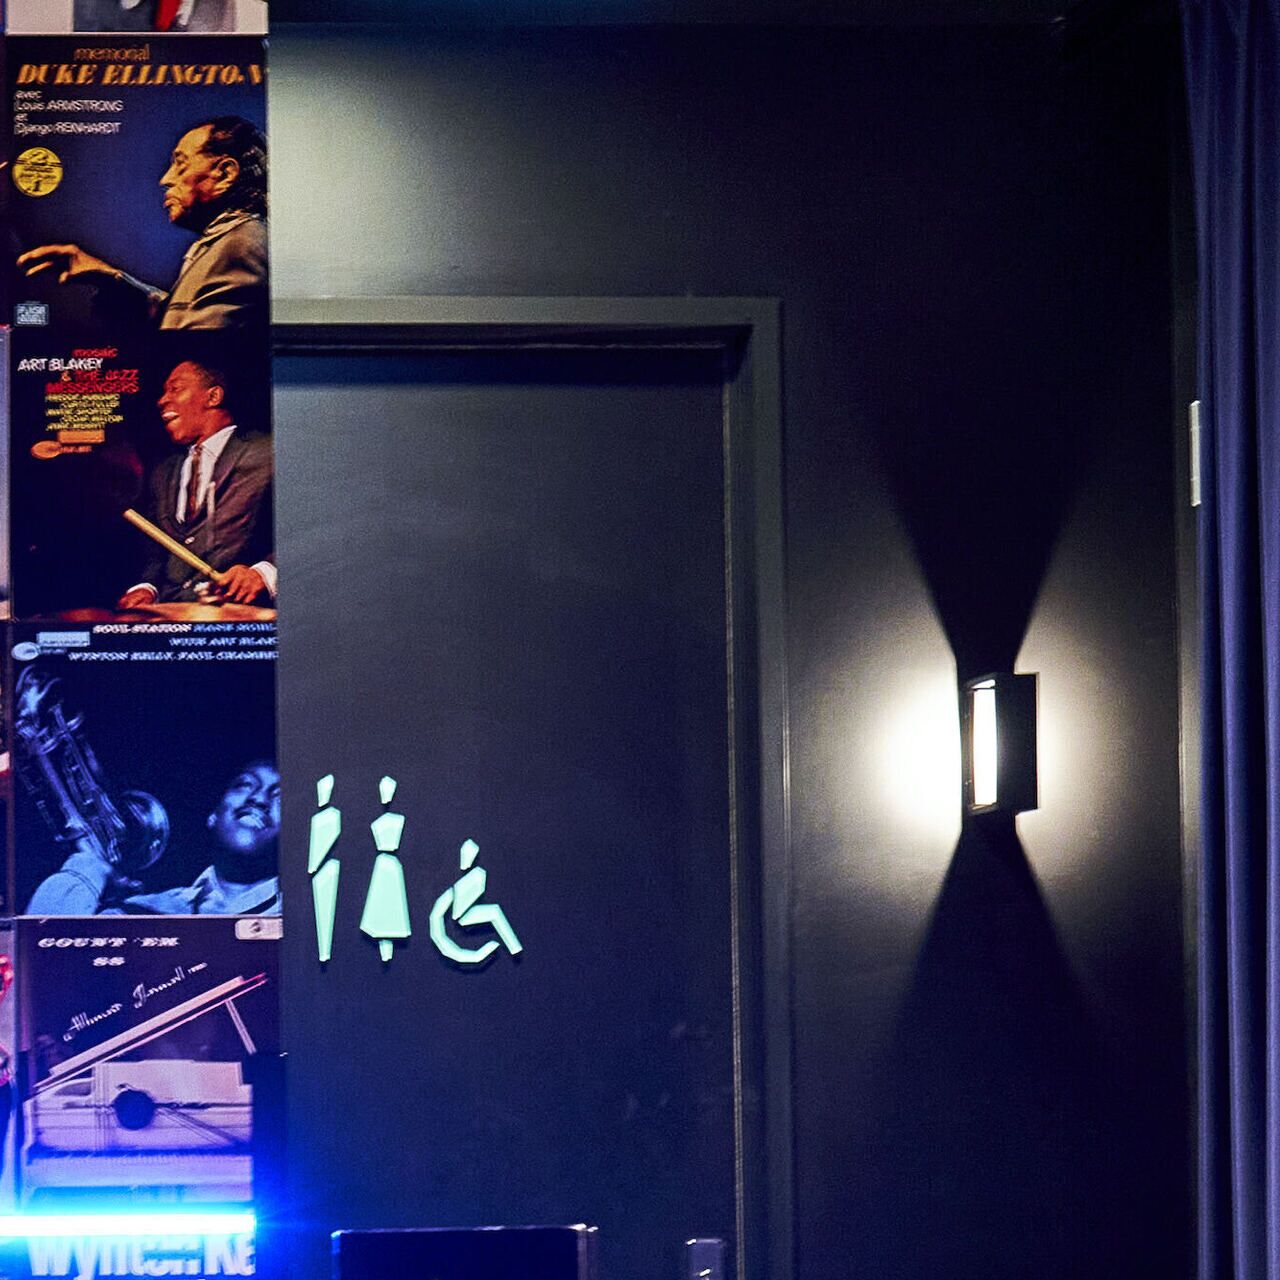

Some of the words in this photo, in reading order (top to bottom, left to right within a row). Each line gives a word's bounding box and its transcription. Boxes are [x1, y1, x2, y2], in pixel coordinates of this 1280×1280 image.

[73, 43, 151, 61] memorial
[16, 64, 98, 86] DUKE
[102, 64, 263, 87] ELLINGTON
[17, 358, 48, 371] ART
[48, 358, 104, 371] BLAKEY
[38, 937, 128, 948] COUNT
